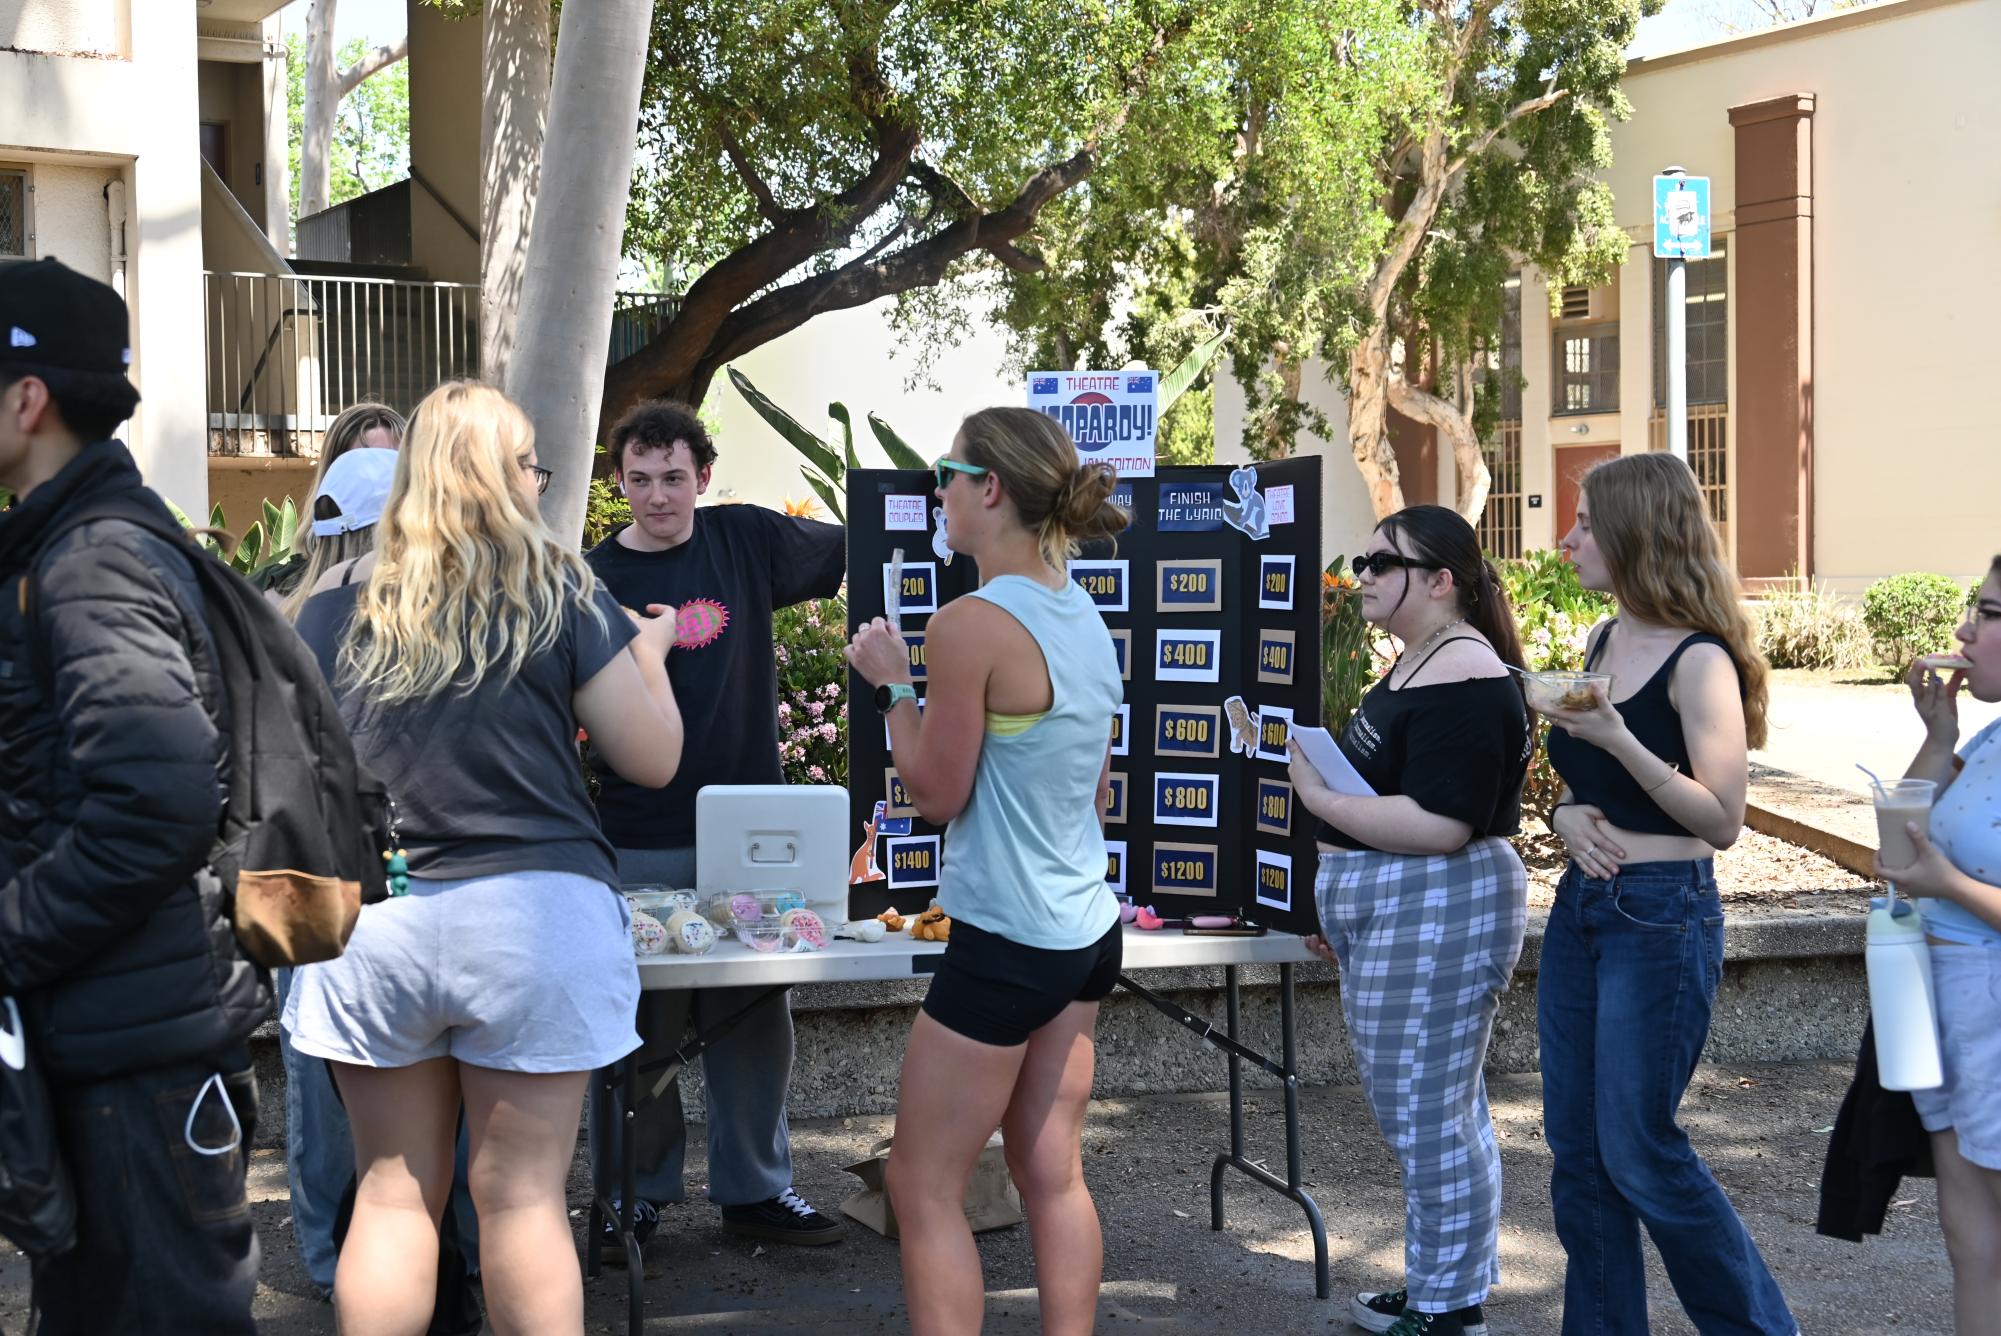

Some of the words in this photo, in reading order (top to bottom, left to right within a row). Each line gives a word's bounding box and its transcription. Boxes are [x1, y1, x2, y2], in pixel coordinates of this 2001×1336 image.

[1066, 377, 1120, 390] THEATRE
[1170, 492, 1210, 504] FINISH
[1158, 508, 1180, 521] THE
[1185, 508, 1222, 521] LYRIC
[902, 577, 925, 596] 200
[1170, 573, 1207, 593] $200
[1266, 573, 1286, 593] $200
[1163, 642, 1206, 666] $400
[1263, 645, 1286, 669] $400
[1165, 718, 1208, 742] $600
[1262, 722, 1285, 746] $600
[1164, 786, 1208, 810] $800
[1263, 795, 1285, 820] $800
[894, 850, 930, 870] $1400
[1161, 860, 1204, 881] $1200
[1261, 867, 1285, 890] $1200
